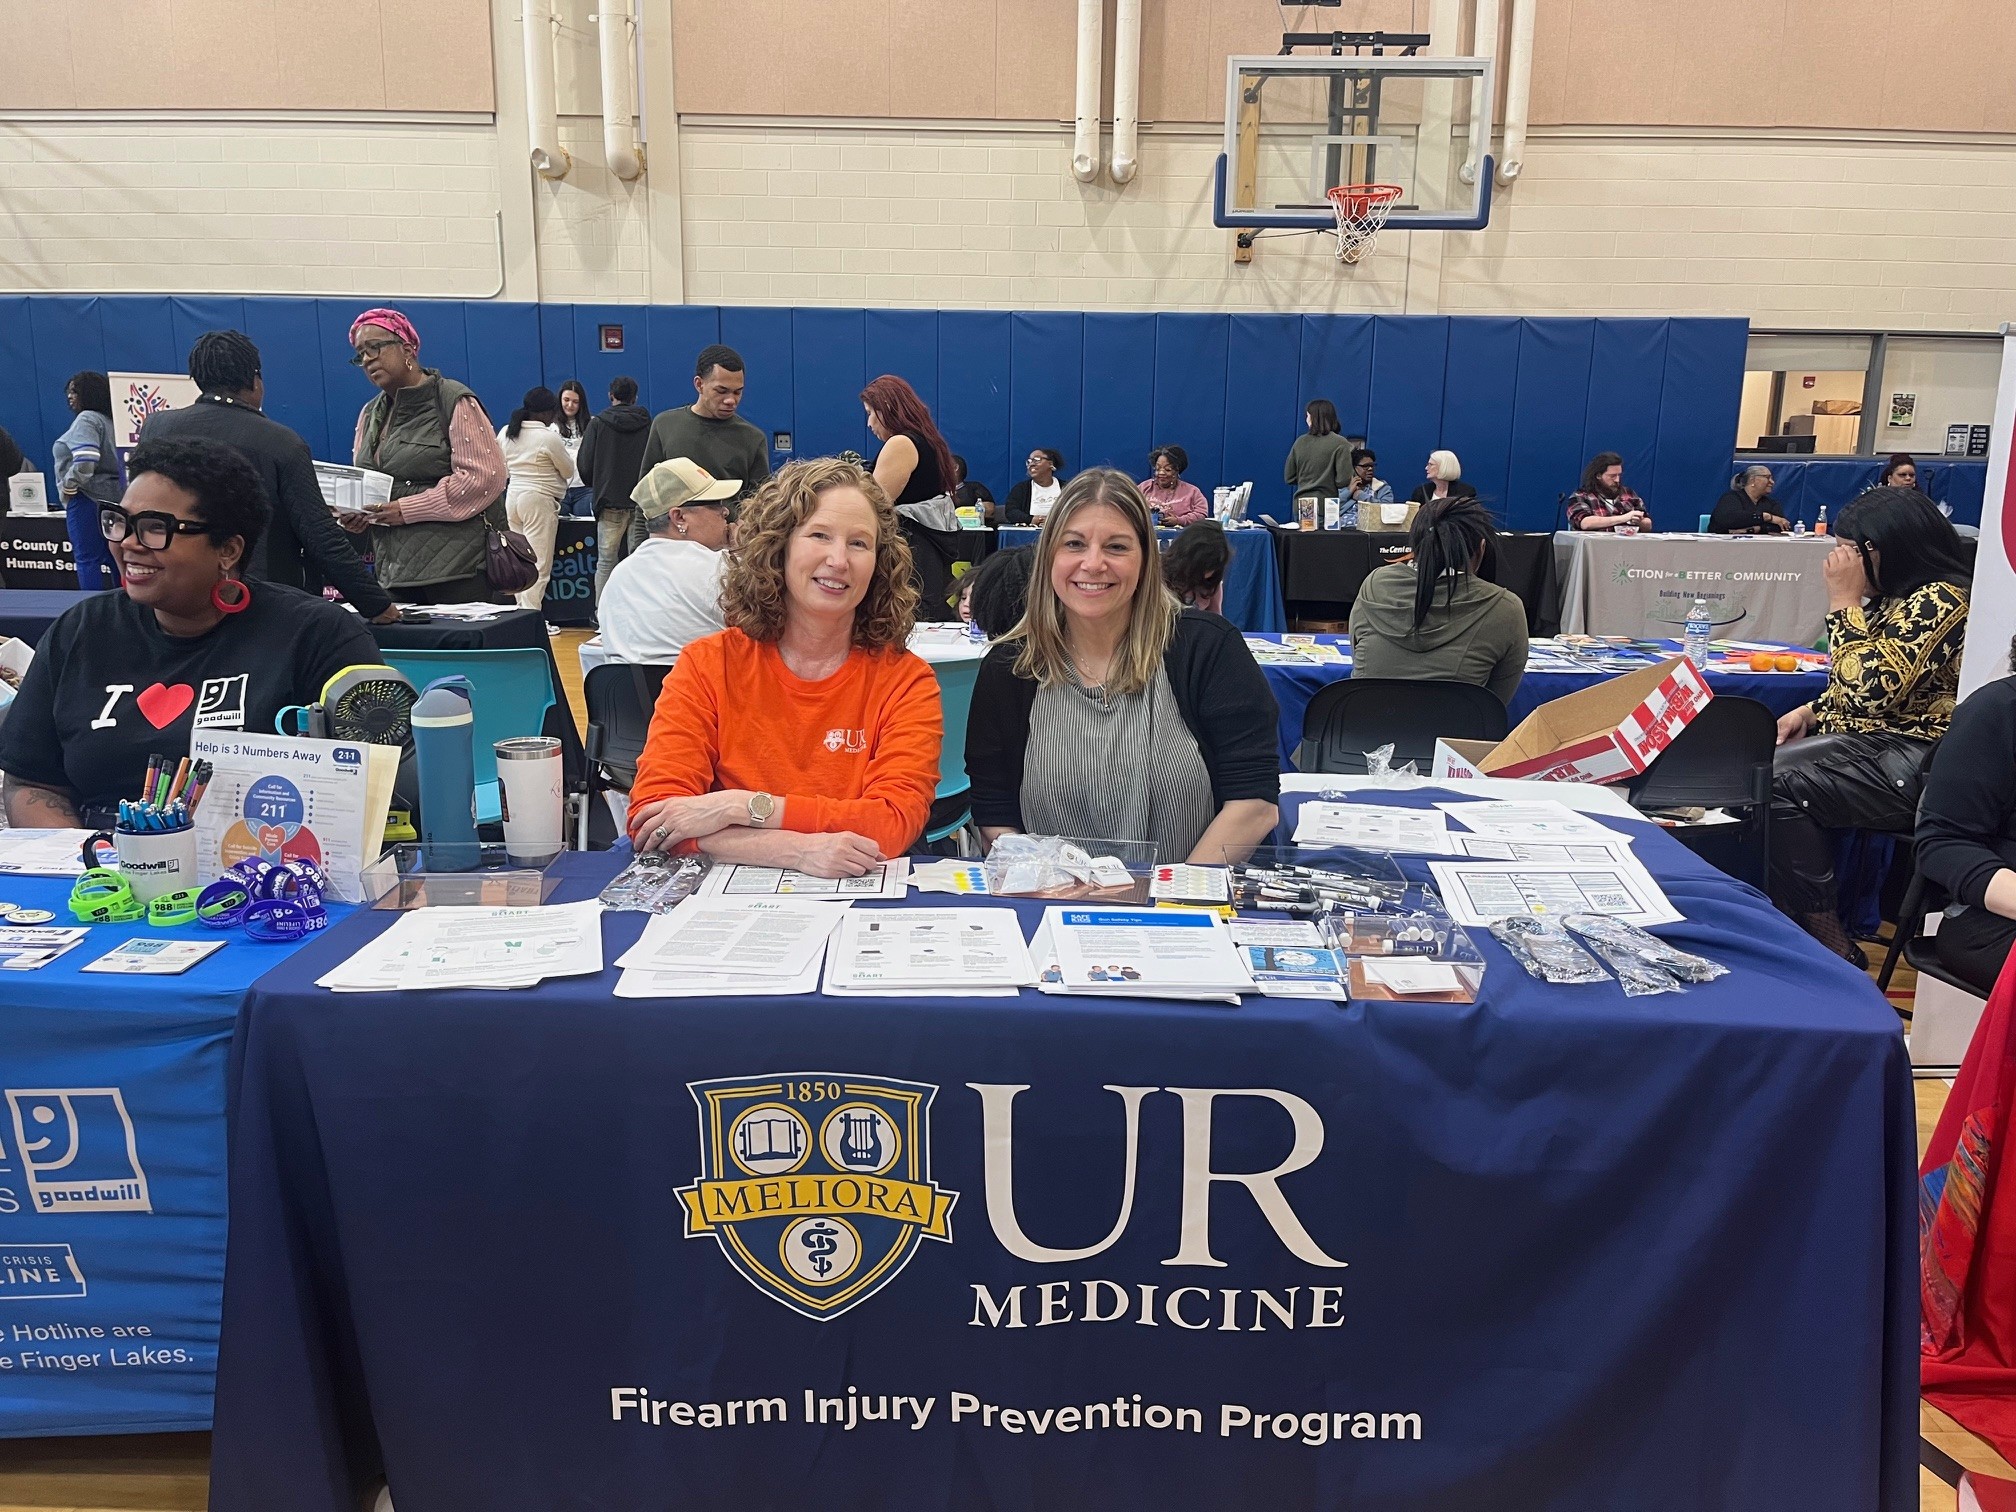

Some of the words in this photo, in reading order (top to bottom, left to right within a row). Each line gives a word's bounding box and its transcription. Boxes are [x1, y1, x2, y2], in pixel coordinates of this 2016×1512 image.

[13, 540, 58, 554] County
[6, 558, 53, 570] Human
[1619, 569, 1663, 579] ACTION
[1678, 570, 1722, 580] BETTER
[1725, 572, 1802, 582] COMMUNITY
[1660, 590, 1680, 599] Building
[91, 684, 134, 730] I
[197, 712, 241, 725] goodwill
[196, 742, 219, 755] Help
[221, 744, 230, 754] is
[234, 745, 239, 755] 3
[242, 746, 289, 760] Numbers
[292, 750, 322, 764] Away
[261, 803, 285, 818] 211
[121, 860, 166, 870] Goodwill
[787, 1082, 841, 1102] 1850
[966, 1082, 1349, 1268] UR
[38, 1184, 140, 1208] goodwill
[713, 1179, 922, 1218] MELIORA
[3, 1256, 52, 1265] CRISIS
[967, 1280, 1346, 1332] MEDICINE
[12, 1323, 105, 1342] Hotline
[112, 1324, 152, 1337] are
[20, 1350, 100, 1371] Finger
[110, 1346, 194, 1366] Lakes.
[610, 1387, 787, 1428] Firearm
[804, 1385, 935, 1431] Injury
[951, 1391, 1202, 1434] Prevention
[1220, 1404, 1422, 1446] Program
